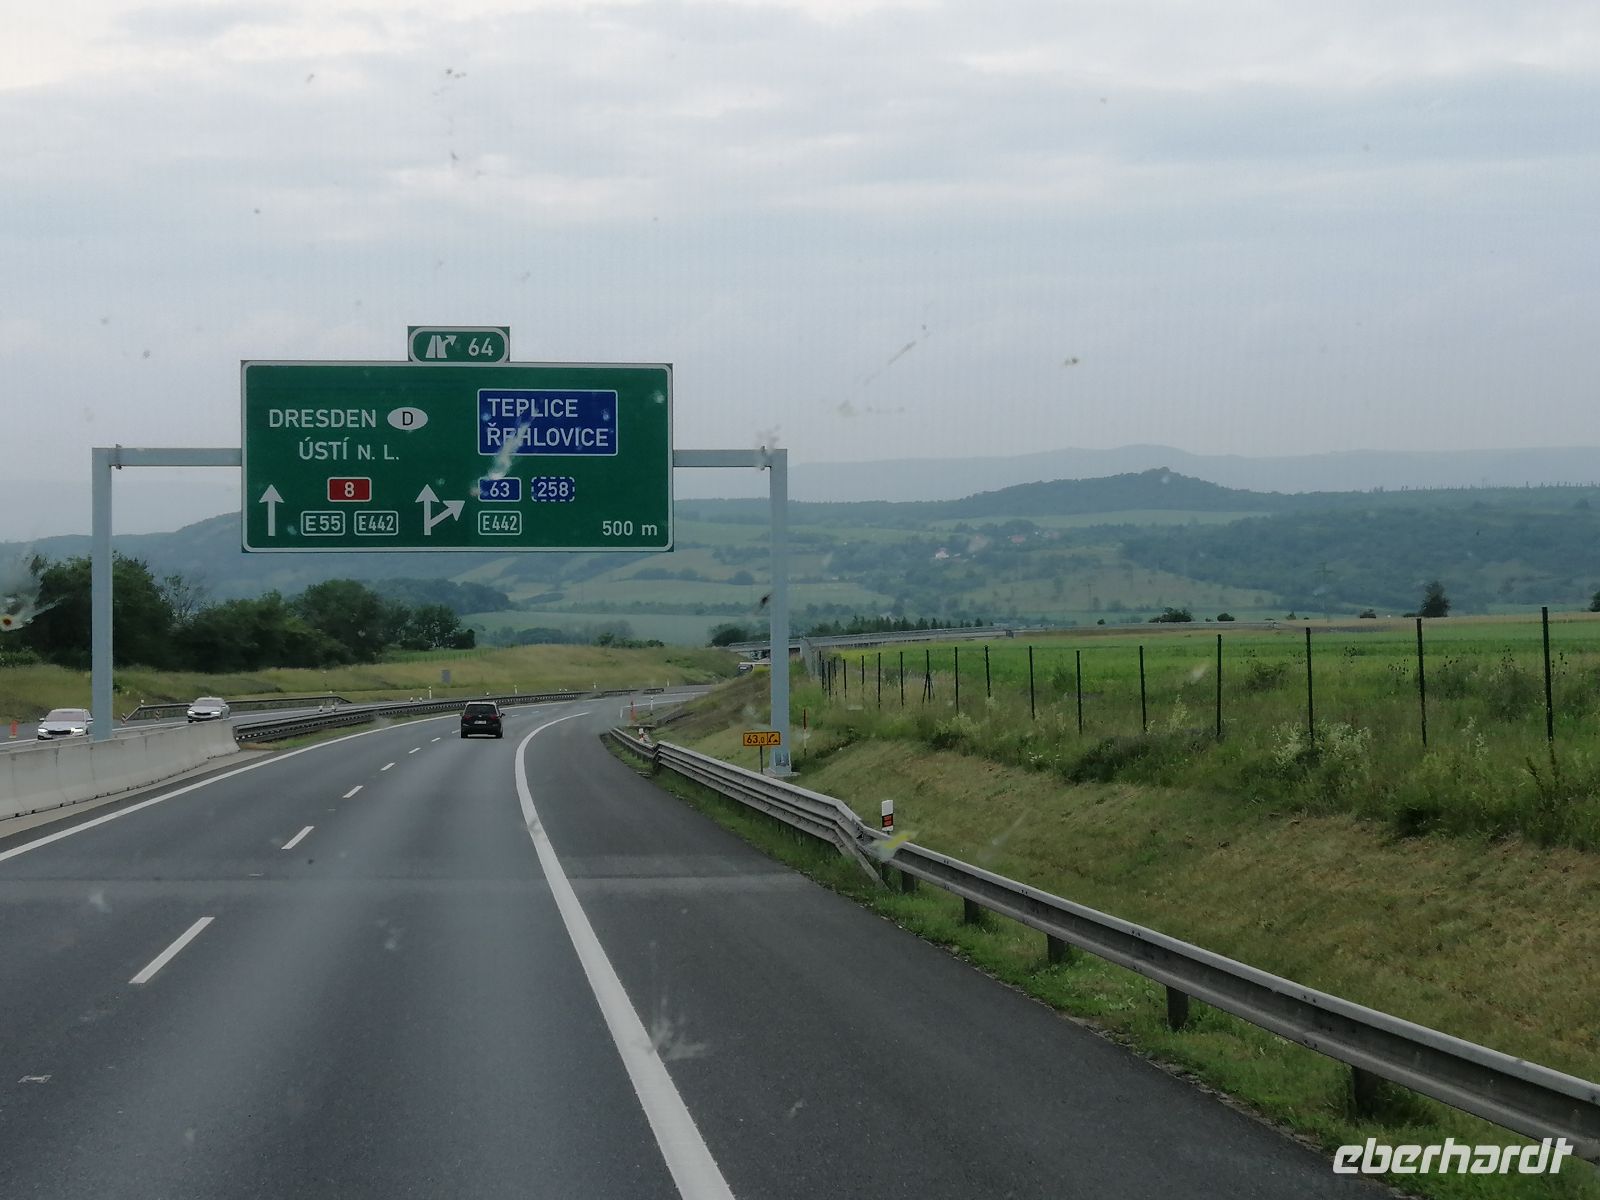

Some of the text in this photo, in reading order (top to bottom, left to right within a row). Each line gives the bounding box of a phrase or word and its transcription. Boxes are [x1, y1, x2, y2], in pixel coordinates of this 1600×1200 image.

[468, 338, 494, 356] 64
[487, 398, 579, 418] TEPLICE
[269, 409, 414, 428] DRESDEN D
[487, 422, 609, 447] ŘEHLOVICE
[299, 436, 400, 461] ÚSTÍ N. L.
[344, 481, 355, 498] 8
[489, 481, 510, 498] 63
[537, 481, 569, 498] 258
[305, 515, 341, 532] E55
[358, 515, 395, 532] E442
[482, 515, 518, 532] E442
[602, 520, 658, 536] 500 m
